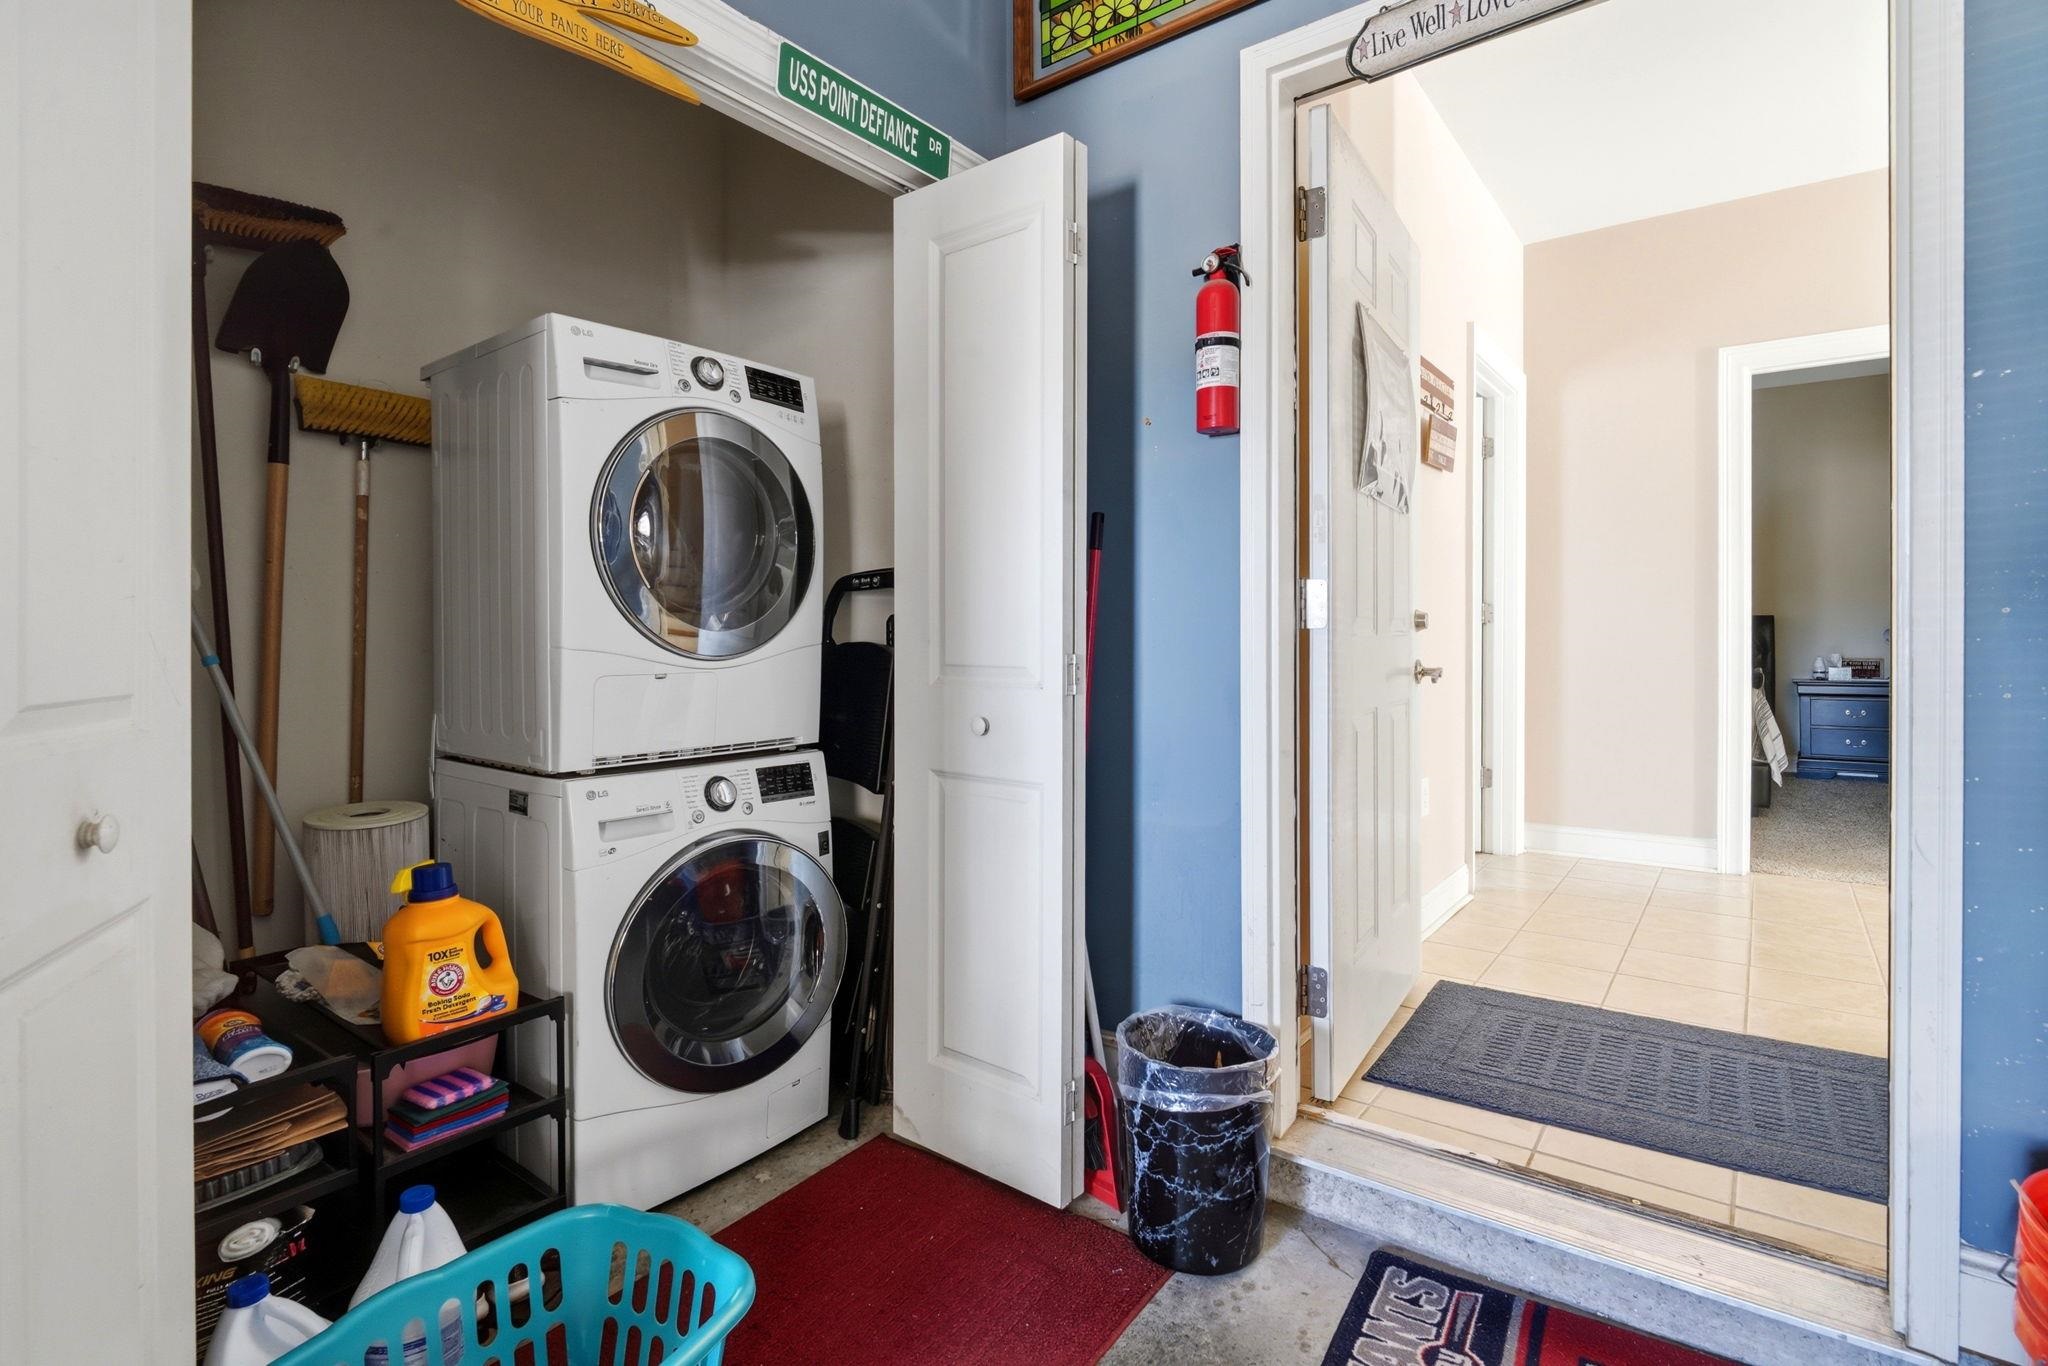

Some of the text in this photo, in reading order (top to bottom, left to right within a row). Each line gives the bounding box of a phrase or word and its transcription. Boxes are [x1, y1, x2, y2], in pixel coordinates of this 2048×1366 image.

[513, 0, 625, 59] YOUR PANTS HERE
[1371, 28, 1406, 58] Live
[1409, 4, 1447, 40] Well
[789, 57, 943, 157] USS POINT DEFIANCE DR
[427, 949, 449, 962] 10X
[428, 992, 471, 1008] Baking Soda
[443, 996, 477, 1011] Detergent
[1347, 1265, 1450, 1366] ANTS
